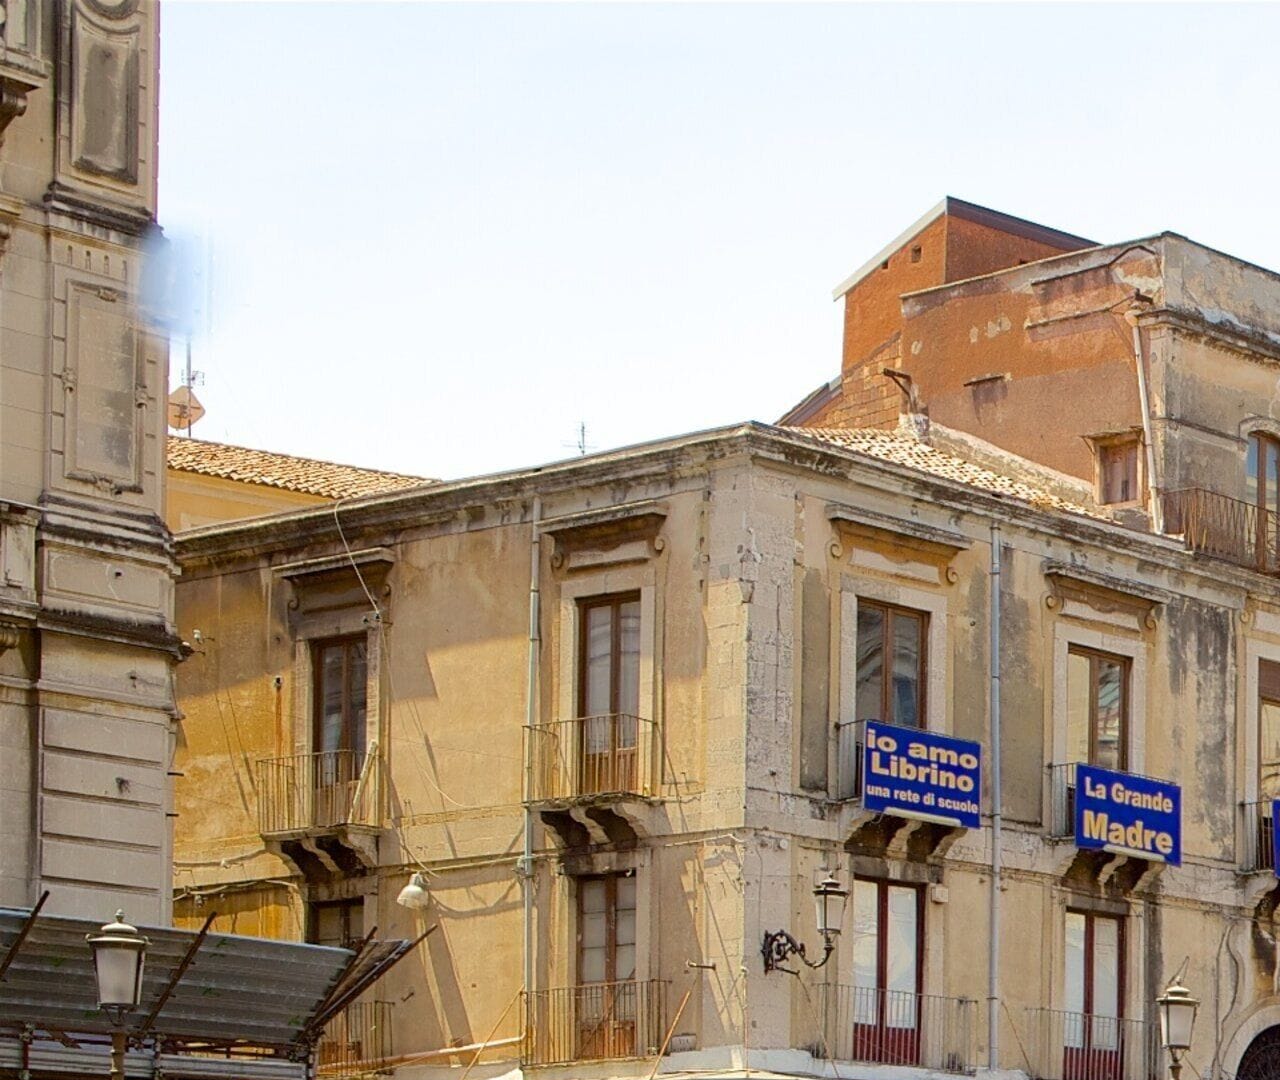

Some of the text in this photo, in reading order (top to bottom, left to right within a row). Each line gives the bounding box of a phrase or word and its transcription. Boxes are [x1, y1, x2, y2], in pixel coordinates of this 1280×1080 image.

[867, 728, 978, 769] io amo
[871, 751, 974, 792] Librino
[866, 784, 978, 814] una rete di scuole
[1085, 776, 1173, 813] La Grande
[1083, 809, 1173, 855] Madre
